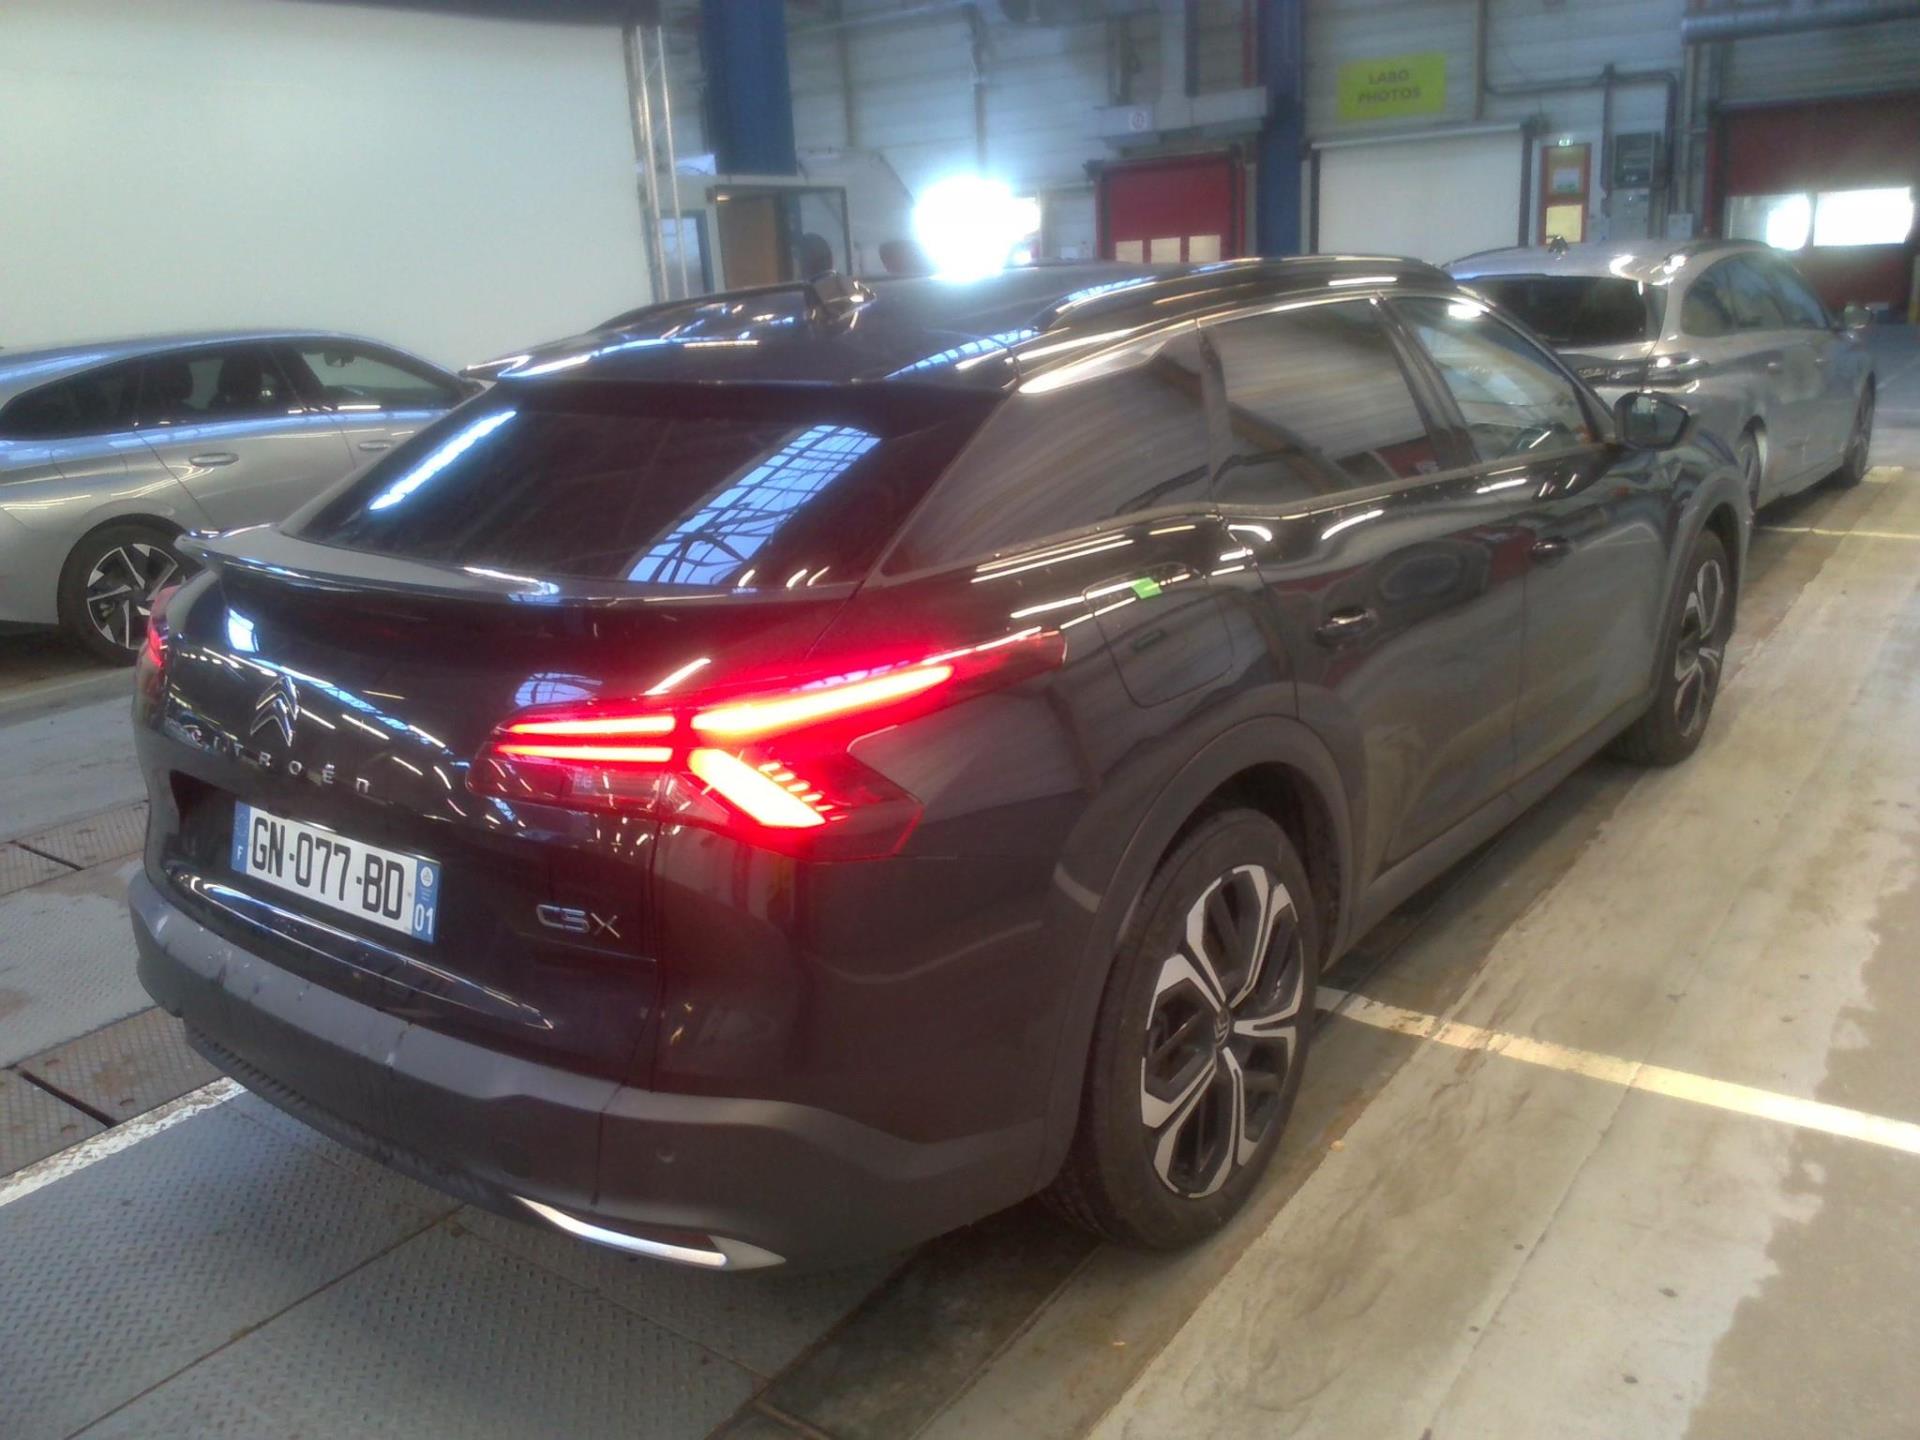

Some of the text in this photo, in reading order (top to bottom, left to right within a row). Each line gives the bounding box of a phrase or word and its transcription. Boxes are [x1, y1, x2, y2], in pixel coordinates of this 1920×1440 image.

[1368, 69, 1411, 85] LABO
[1358, 87, 1421, 104] PHOTOS
[236, 845, 244, 860] F
[252, 816, 405, 920] GN-077-BD
[414, 903, 434, 935] 01
